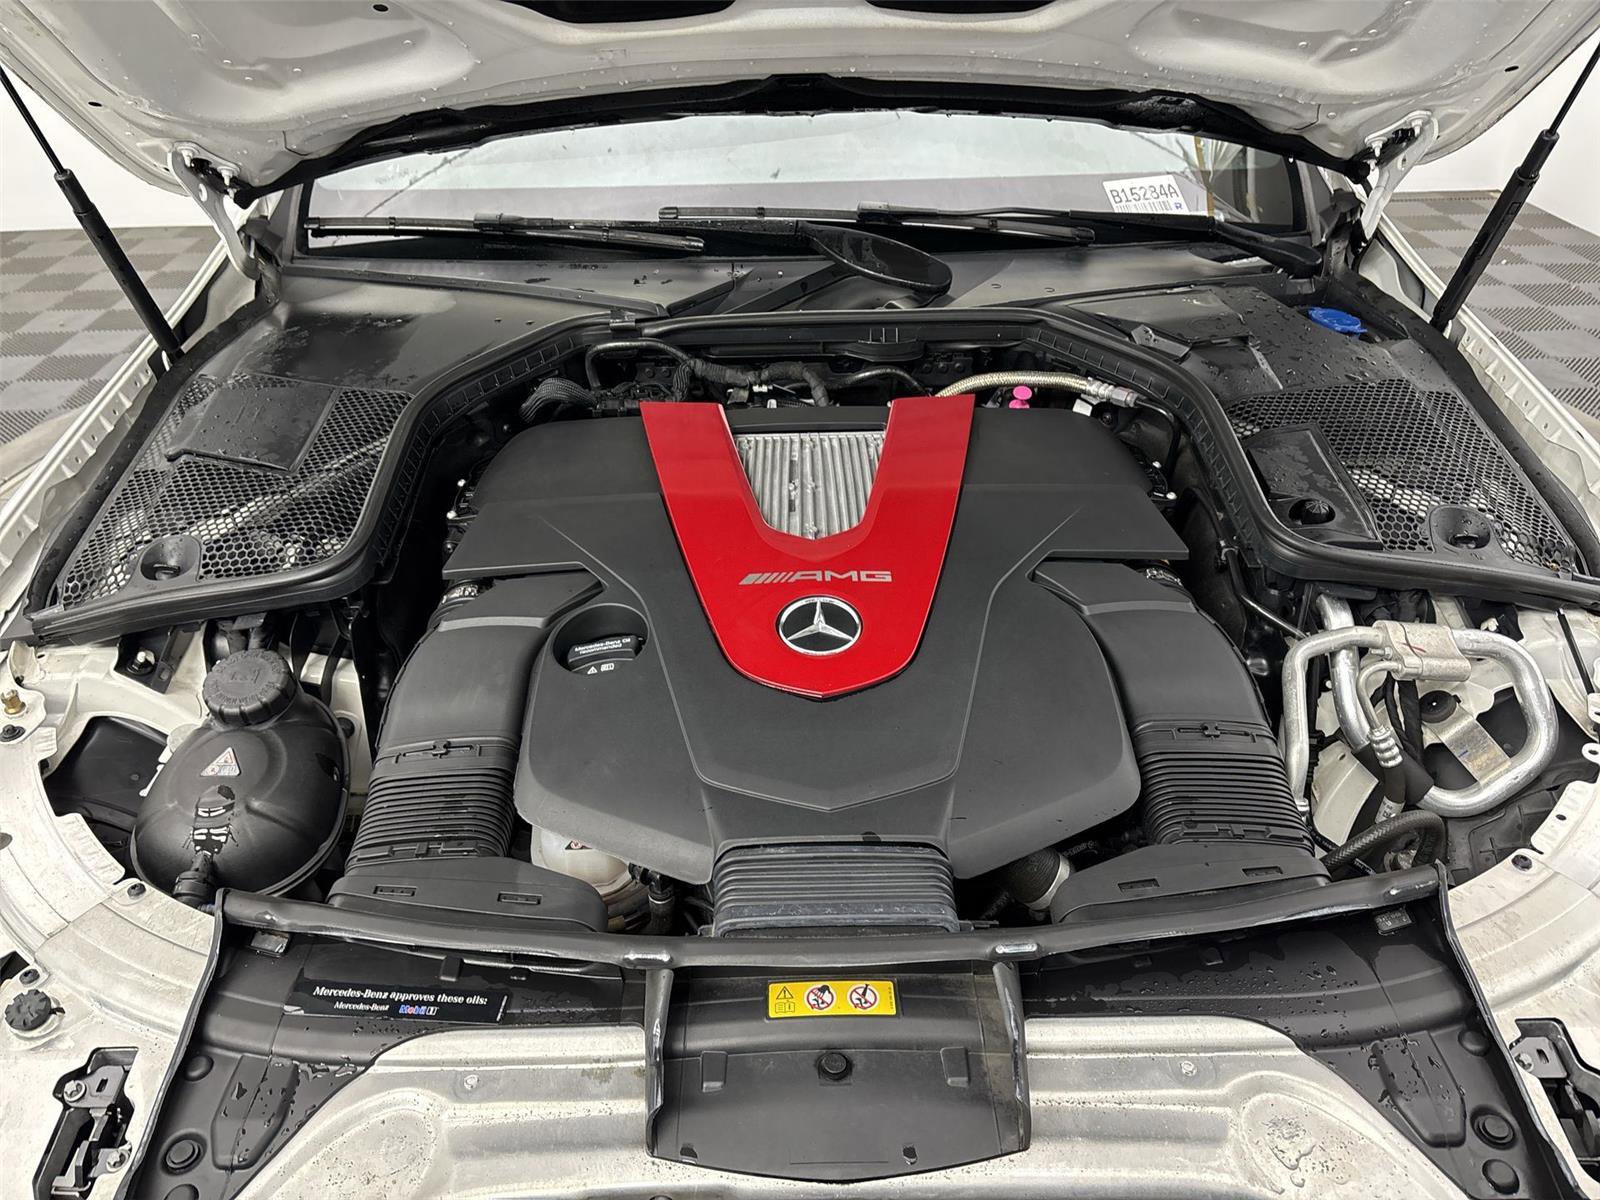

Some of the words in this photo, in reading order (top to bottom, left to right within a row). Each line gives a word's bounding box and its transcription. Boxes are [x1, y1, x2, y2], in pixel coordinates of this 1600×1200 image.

[788, 570, 893, 582] AMG
[312, 986, 389, 999] Mercedes-Benz
[389, 991, 435, 1002] approves
[437, 993, 465, 1004] these
[333, 1001, 390, 1011] Mercedes-Benz
[399, 1004, 426, 1015] Mobil
